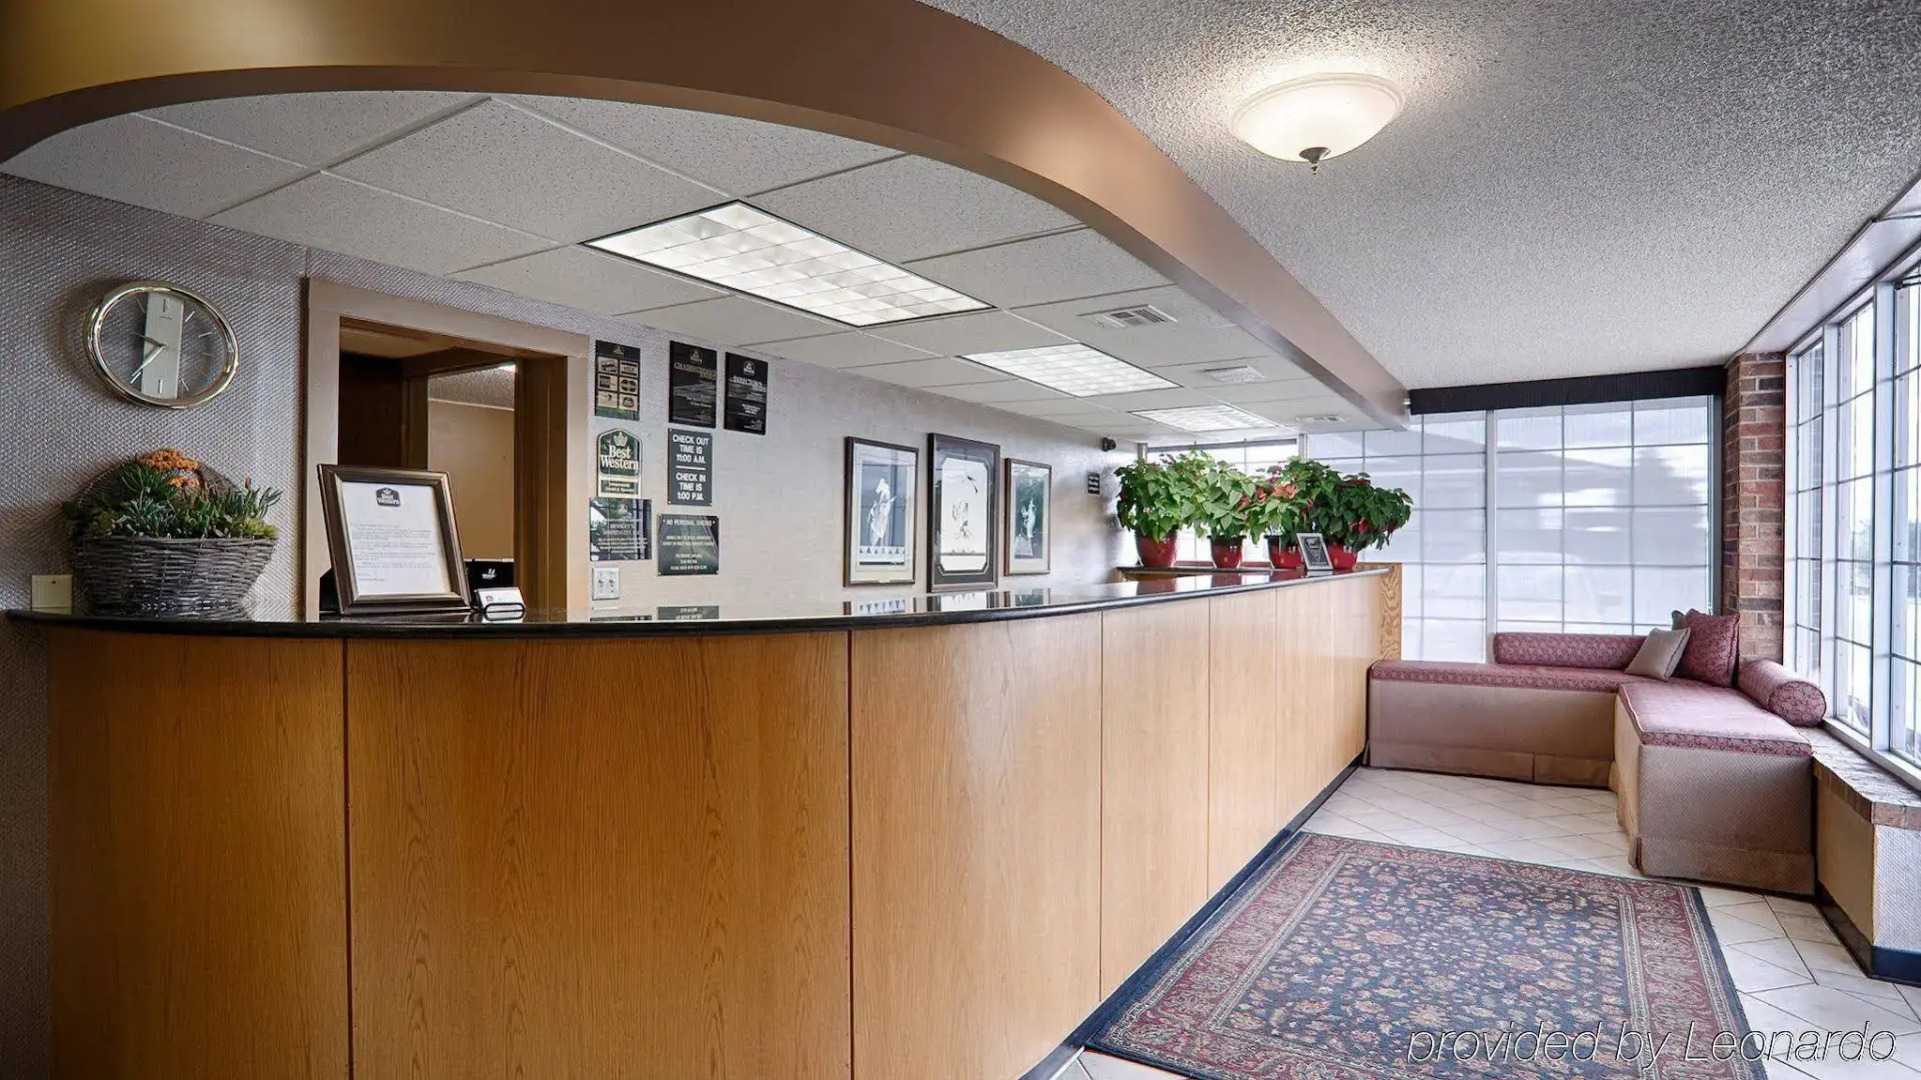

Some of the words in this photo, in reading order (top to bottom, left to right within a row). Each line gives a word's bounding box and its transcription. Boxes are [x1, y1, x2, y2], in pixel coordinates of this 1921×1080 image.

[672, 434, 695, 444] CHECK
[696, 437, 709, 446] OUT
[608, 444, 631, 460] Best
[679, 444, 694, 454] TIME
[696, 446, 703, 454] IS
[600, 454, 639, 470] Western
[693, 455, 706, 464] A.M.
[675, 472, 698, 482] CHECK
[699, 474, 707, 482] IN
[679, 482, 695, 491] TIME
[695, 483, 703, 491] IS
[674, 519, 696, 527] PERSONAL
